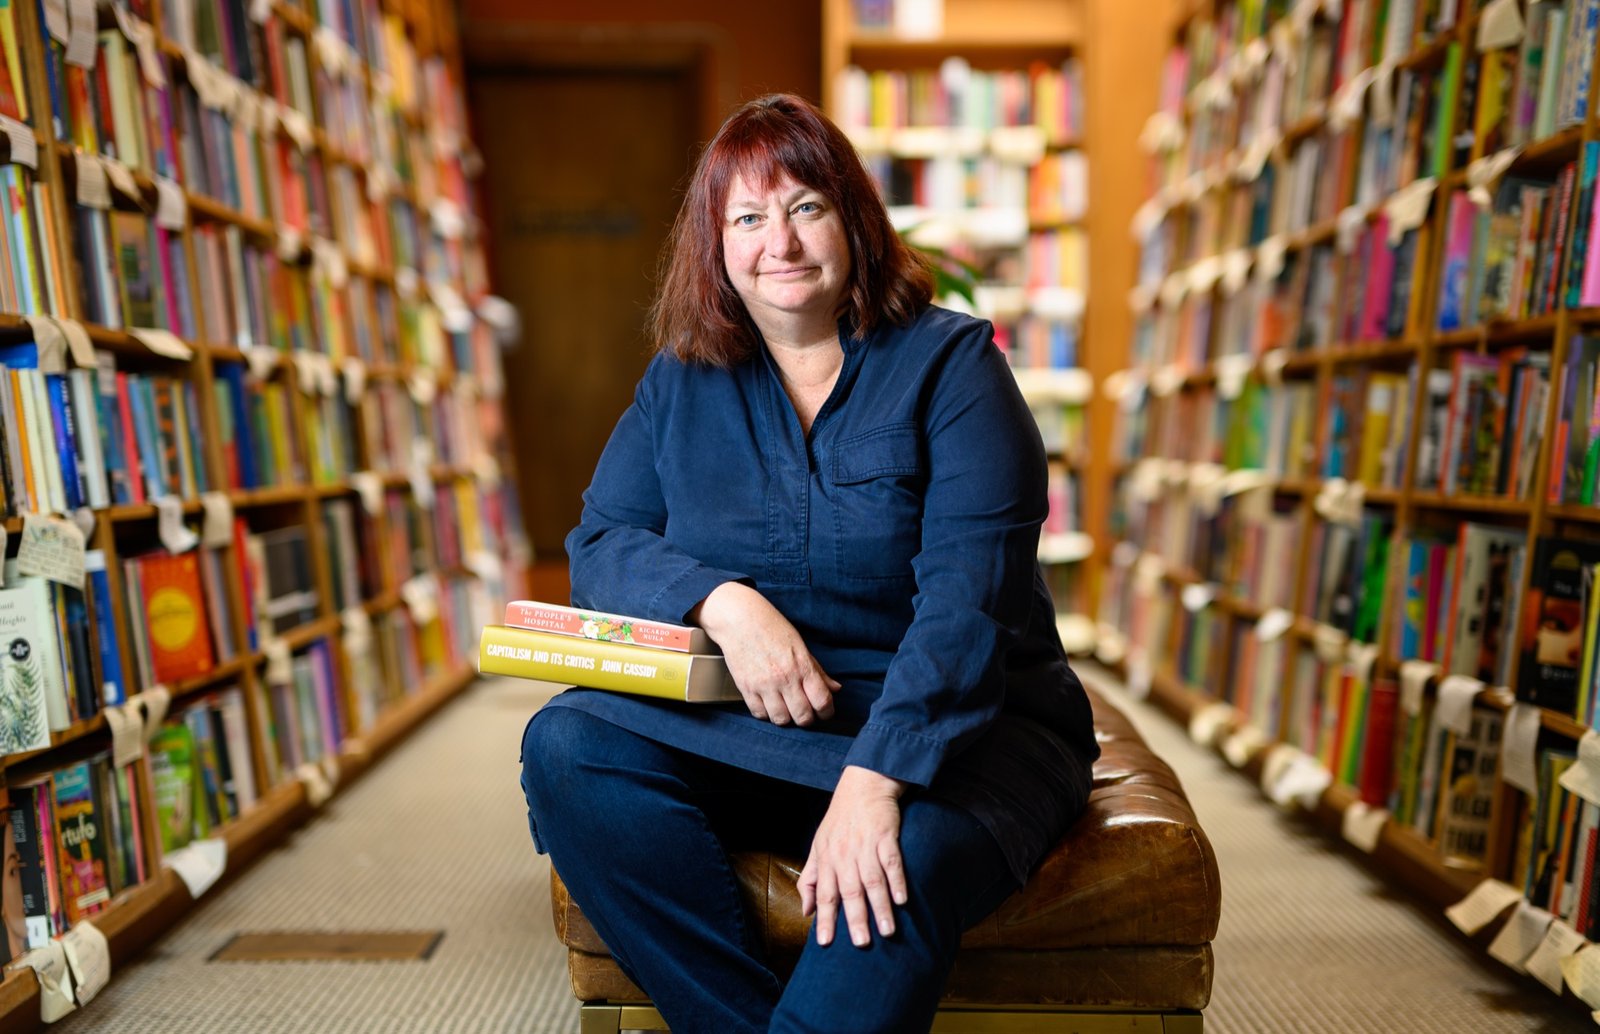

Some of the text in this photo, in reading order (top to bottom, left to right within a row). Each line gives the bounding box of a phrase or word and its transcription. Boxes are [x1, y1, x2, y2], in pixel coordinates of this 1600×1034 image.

[520, 608, 572, 621] The PEOPLE'S
[524, 617, 565, 629] HOSPITAL
[639, 627, 670, 636] RICARDO
[643, 634, 664, 643] NUILA
[486, 644, 595, 670] CAPITALISM AND ITS CRITICS
[601, 659, 622, 674] JOHN
[623, 662, 657, 678] CASSIDY
